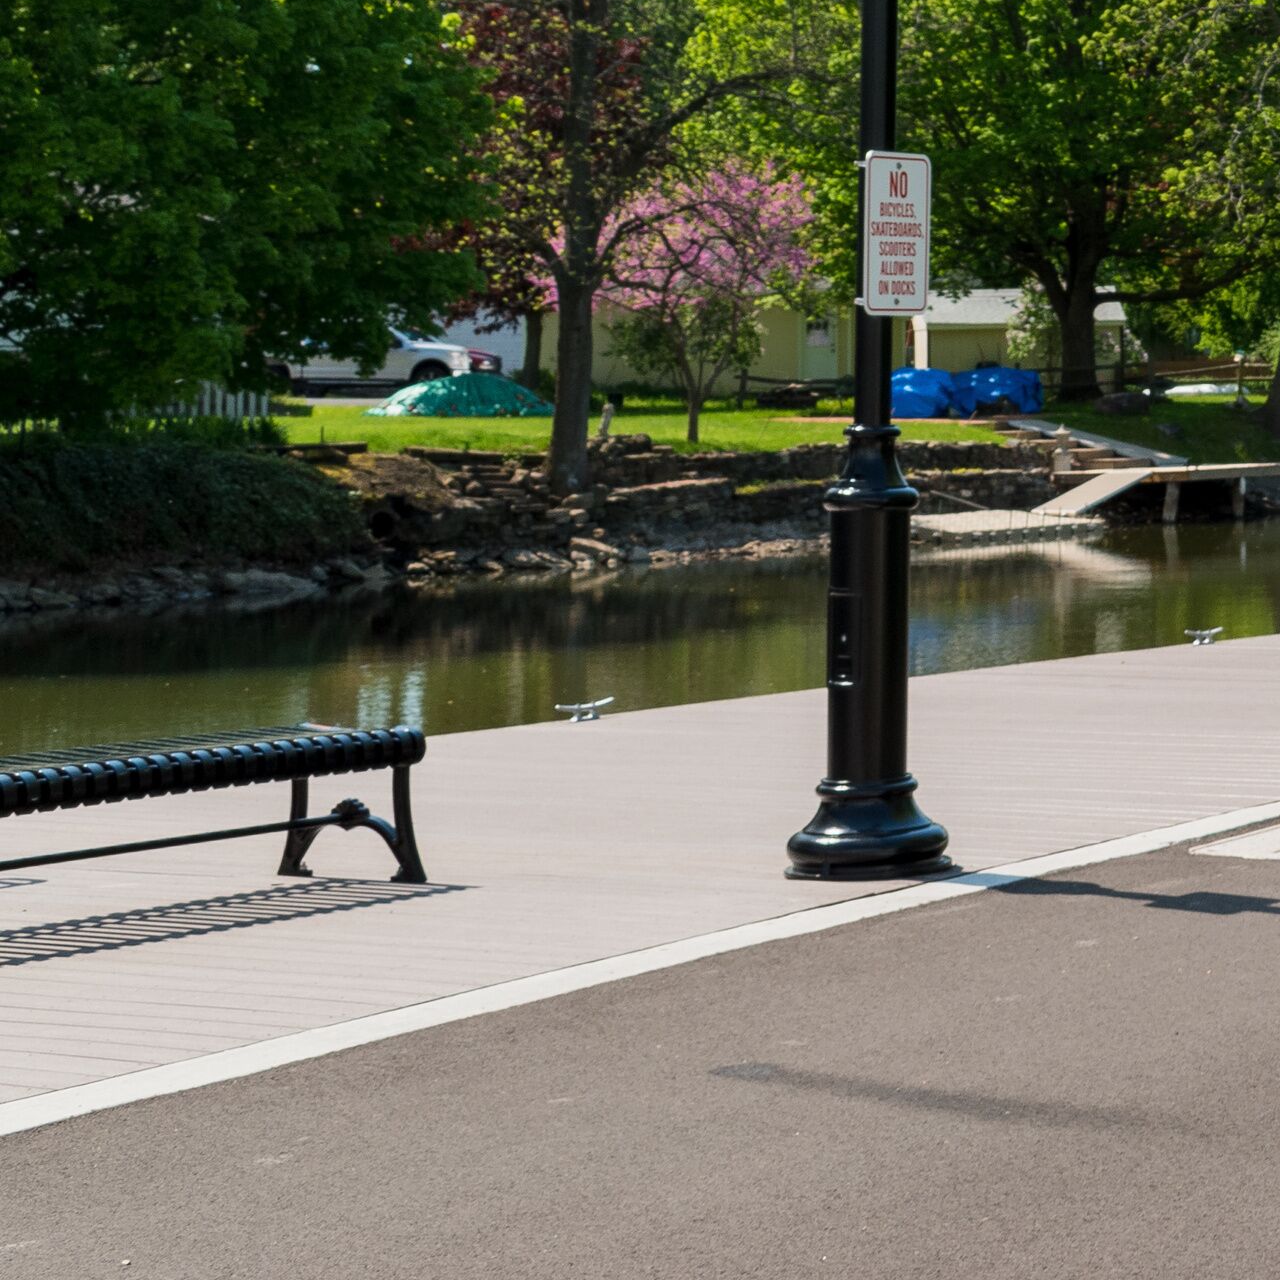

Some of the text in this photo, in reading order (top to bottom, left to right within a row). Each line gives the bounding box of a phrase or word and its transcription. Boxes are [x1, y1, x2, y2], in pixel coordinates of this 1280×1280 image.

[889, 171, 908, 198] NO
[879, 202, 917, 219] BICYCLES,
[871, 221, 924, 239] SKATEBOARDS,
[878, 241, 916, 257] SCOOTERS
[880, 261, 914, 276] ALLOWED
[878, 281, 916, 296] ON DOCKS
